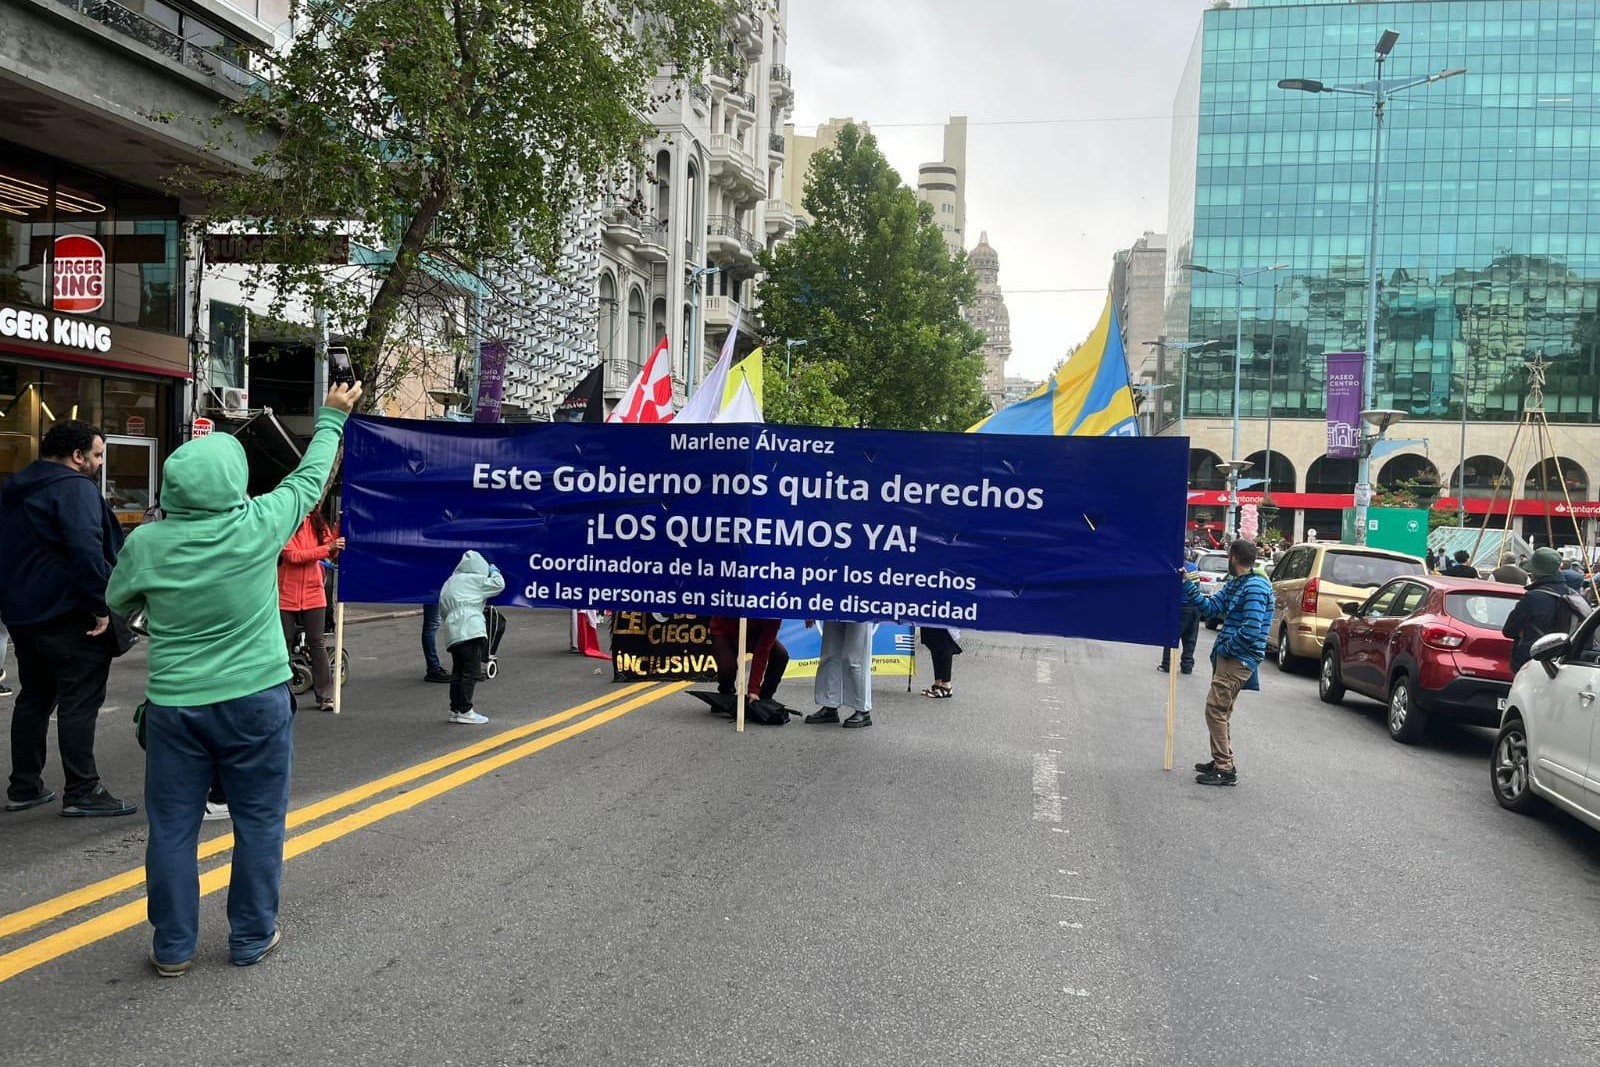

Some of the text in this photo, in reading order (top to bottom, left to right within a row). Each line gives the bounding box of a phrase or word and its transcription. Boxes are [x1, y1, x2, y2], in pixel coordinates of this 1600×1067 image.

[54, 317, 112, 352] KING
[671, 430, 834, 453] Marlene Álvarez
[473, 463, 1044, 509] Este Gobierno nos quita derechos
[587, 514, 917, 552] ¡LOS QUEREMOS YA!
[529, 554, 976, 590] Coordinadora de la Marcha por los derechos
[525, 582, 977, 620] de las personas en situación de discapacidad
[648, 623, 713, 645] CIEGO
[872, 656, 900, 664] Personas
